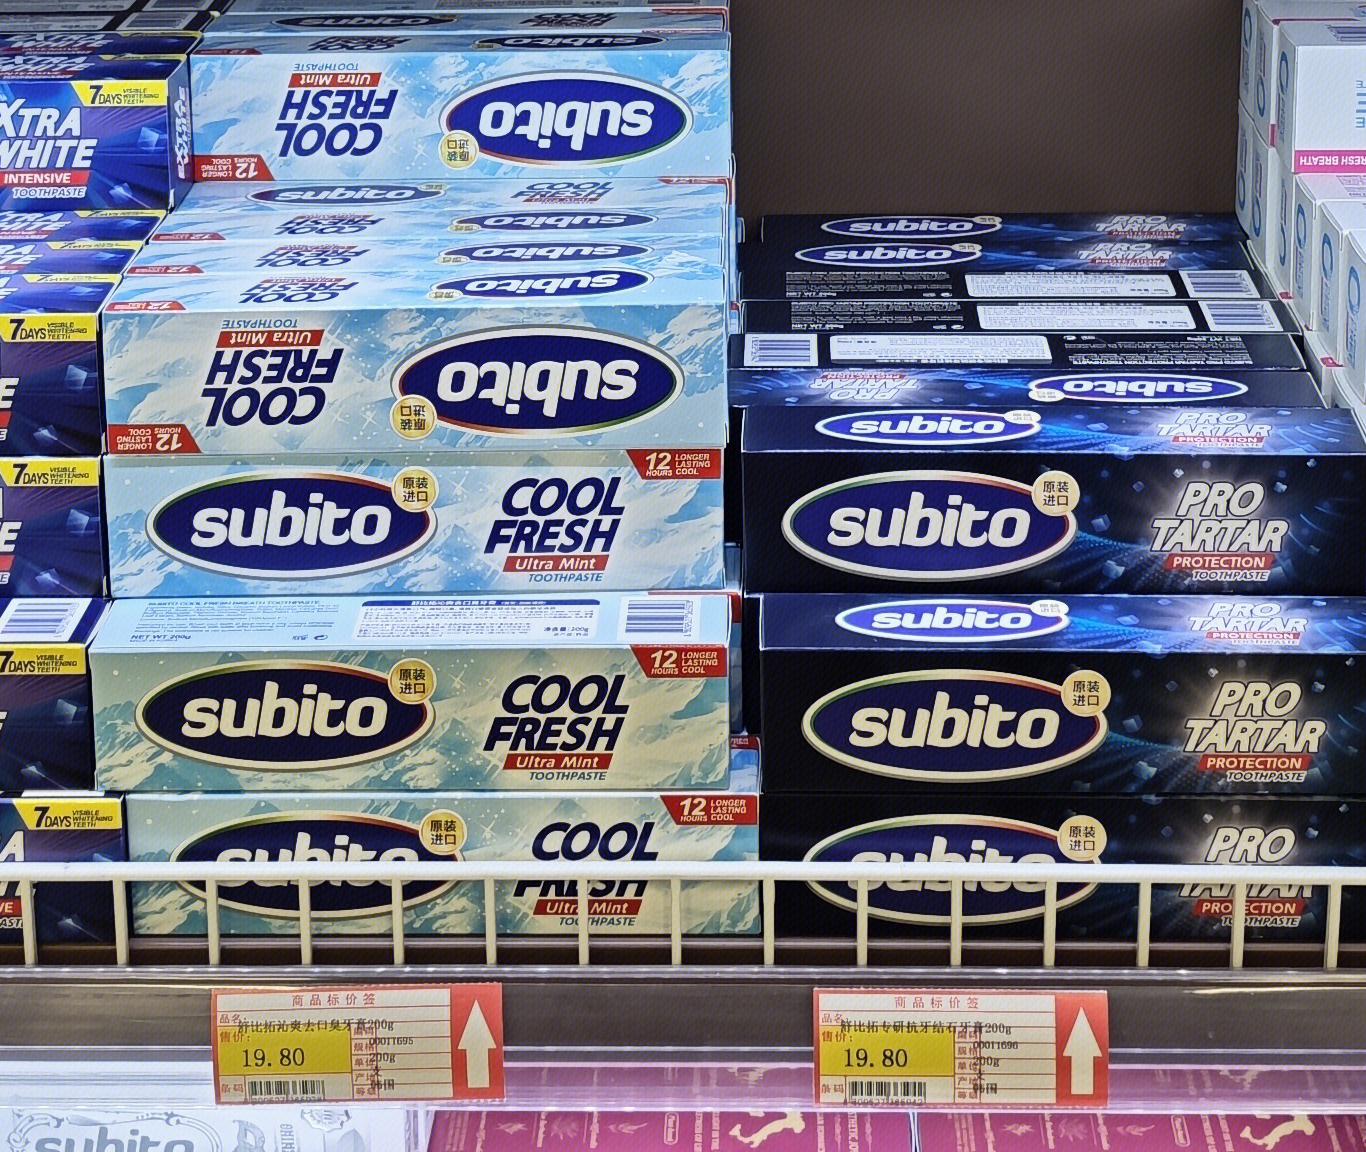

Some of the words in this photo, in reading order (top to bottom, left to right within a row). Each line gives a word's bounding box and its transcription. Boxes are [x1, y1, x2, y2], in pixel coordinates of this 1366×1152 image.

[294, 62, 360, 71] TOOTHPASTE
[298, 74, 331, 85] Mint
[335, 74, 371, 85] Ultra
[280, 90, 398, 119] FRESH
[479, 99, 654, 150] subito
[279, 122, 383, 157] COOL
[1299, 155, 1339, 166] BREATH
[4, 173, 71, 184] INTENSIVE
[14, 187, 86, 199] TOOTHPASTE
[1042, 480, 1068, 494] 原装
[1042, 495, 1068, 507] 进口
[1176, 483, 1263, 516] PRO
[827, 492, 1030, 548] subito
[1151, 520, 1289, 554] TARTAR
[1173, 556, 1265, 568] PROTECTION
[1192, 570, 1268, 581] TOOTHPASTE
[651, 650, 677, 667] 12
[682, 659, 717, 667] LASTING
[400, 668, 426, 681] 原装
[650, 666, 679, 675] HOURS
[682, 666, 706, 674] COOL
[400, 682, 426, 695] 进口
[502, 675, 630, 714] COOL
[182, 682, 388, 738] subito
[485, 717, 625, 751] FRESH
[516, 755, 560, 769] Ultra
[565, 755, 599, 769] Mint
[530, 772, 607, 781] TOOTHPASTE
[243, 1048, 304, 1067] 19.80
[845, 1048, 908, 1067] 19.80
